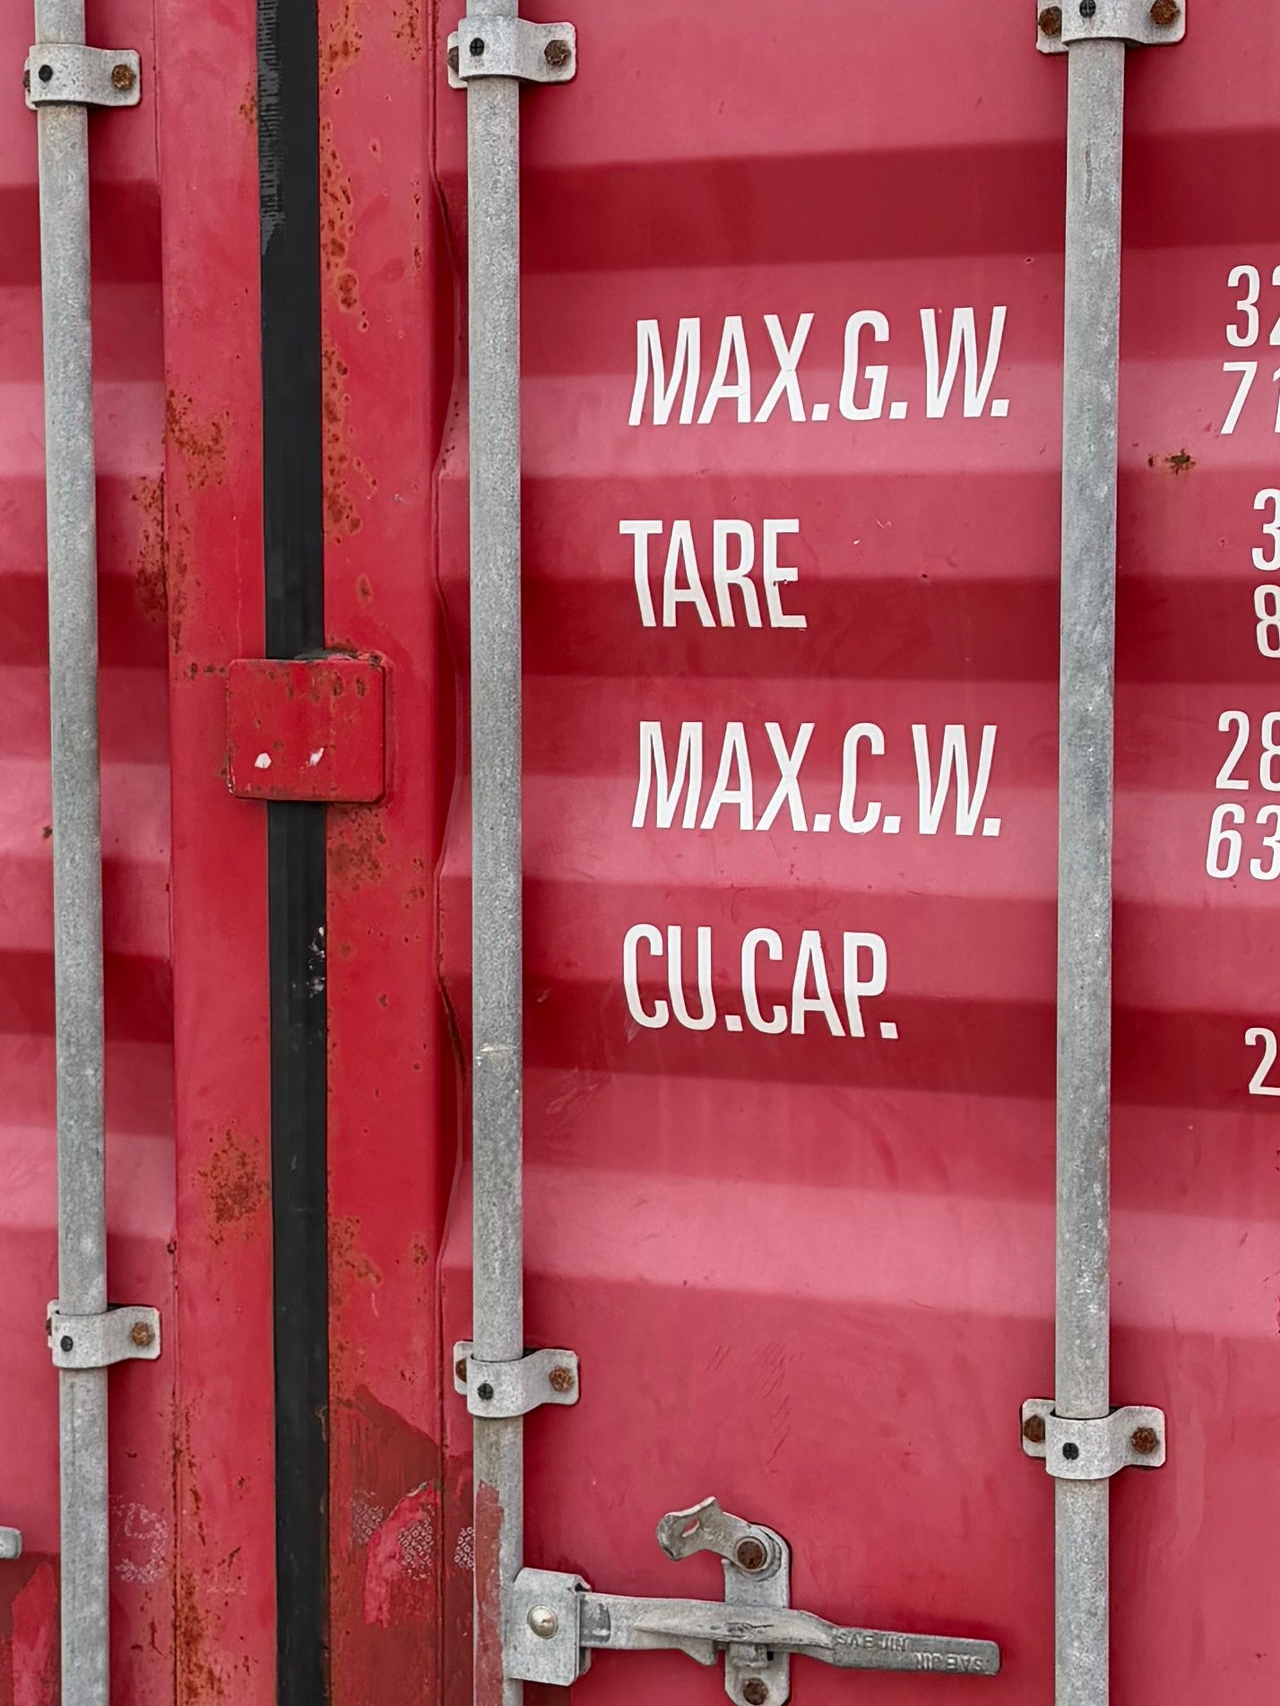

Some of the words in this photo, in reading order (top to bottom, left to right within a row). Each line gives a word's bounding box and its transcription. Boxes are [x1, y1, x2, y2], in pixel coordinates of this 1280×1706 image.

[628, 306, 1010, 425] MAX.G.W.
[620, 518, 806, 628] TARE
[631, 721, 1001, 837] MAX.C.W.
[623, 923, 898, 1039] CU.CAP.
